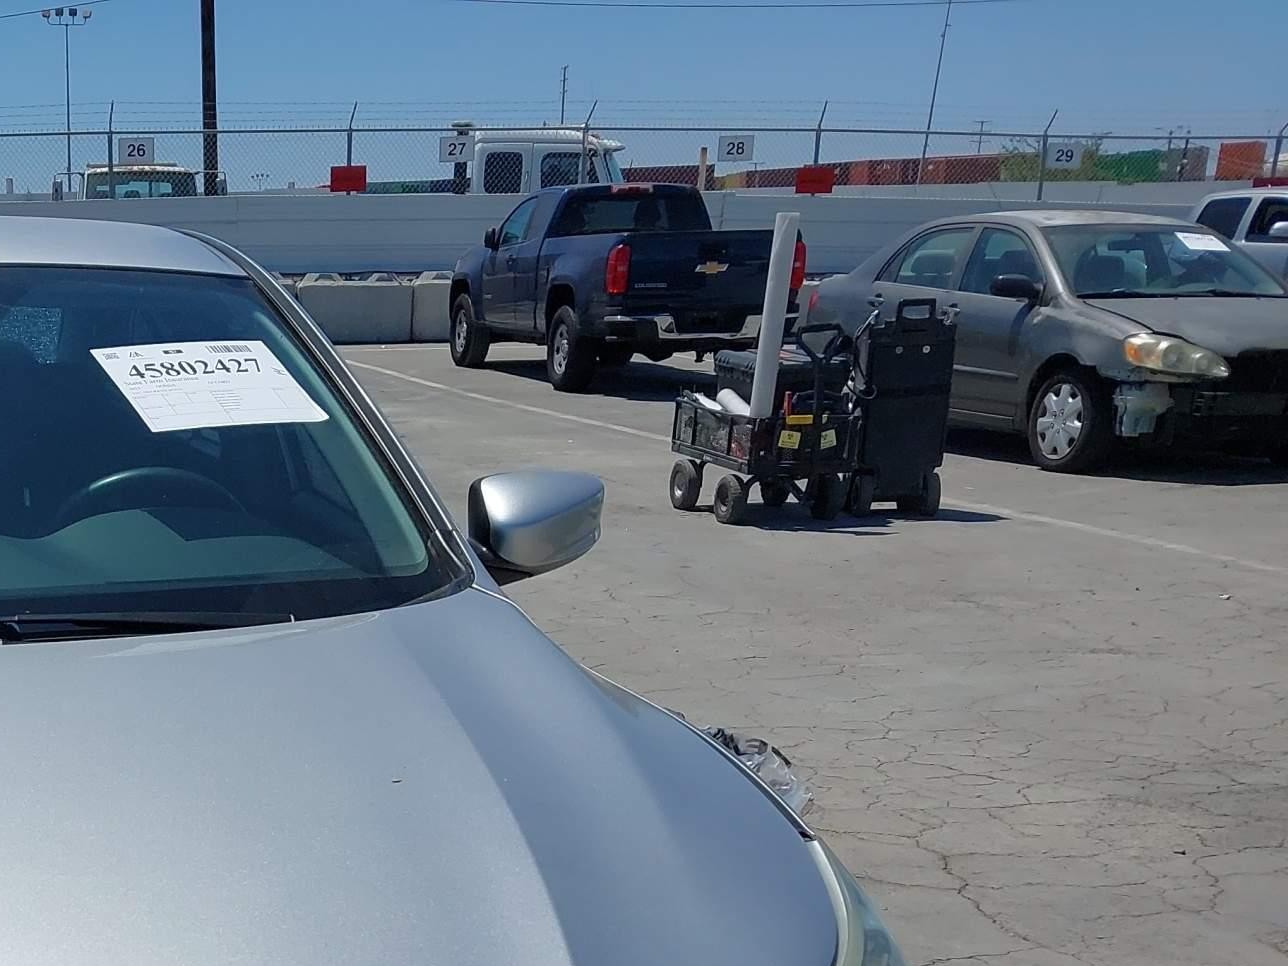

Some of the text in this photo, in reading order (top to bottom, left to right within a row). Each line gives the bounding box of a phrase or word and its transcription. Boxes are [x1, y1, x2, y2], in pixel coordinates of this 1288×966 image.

[127, 143, 146, 157] 26
[447, 142, 466, 156] 27
[726, 141, 745, 155] 28
[1055, 149, 1074, 162] 29
[128, 358, 261, 379] 45802427
